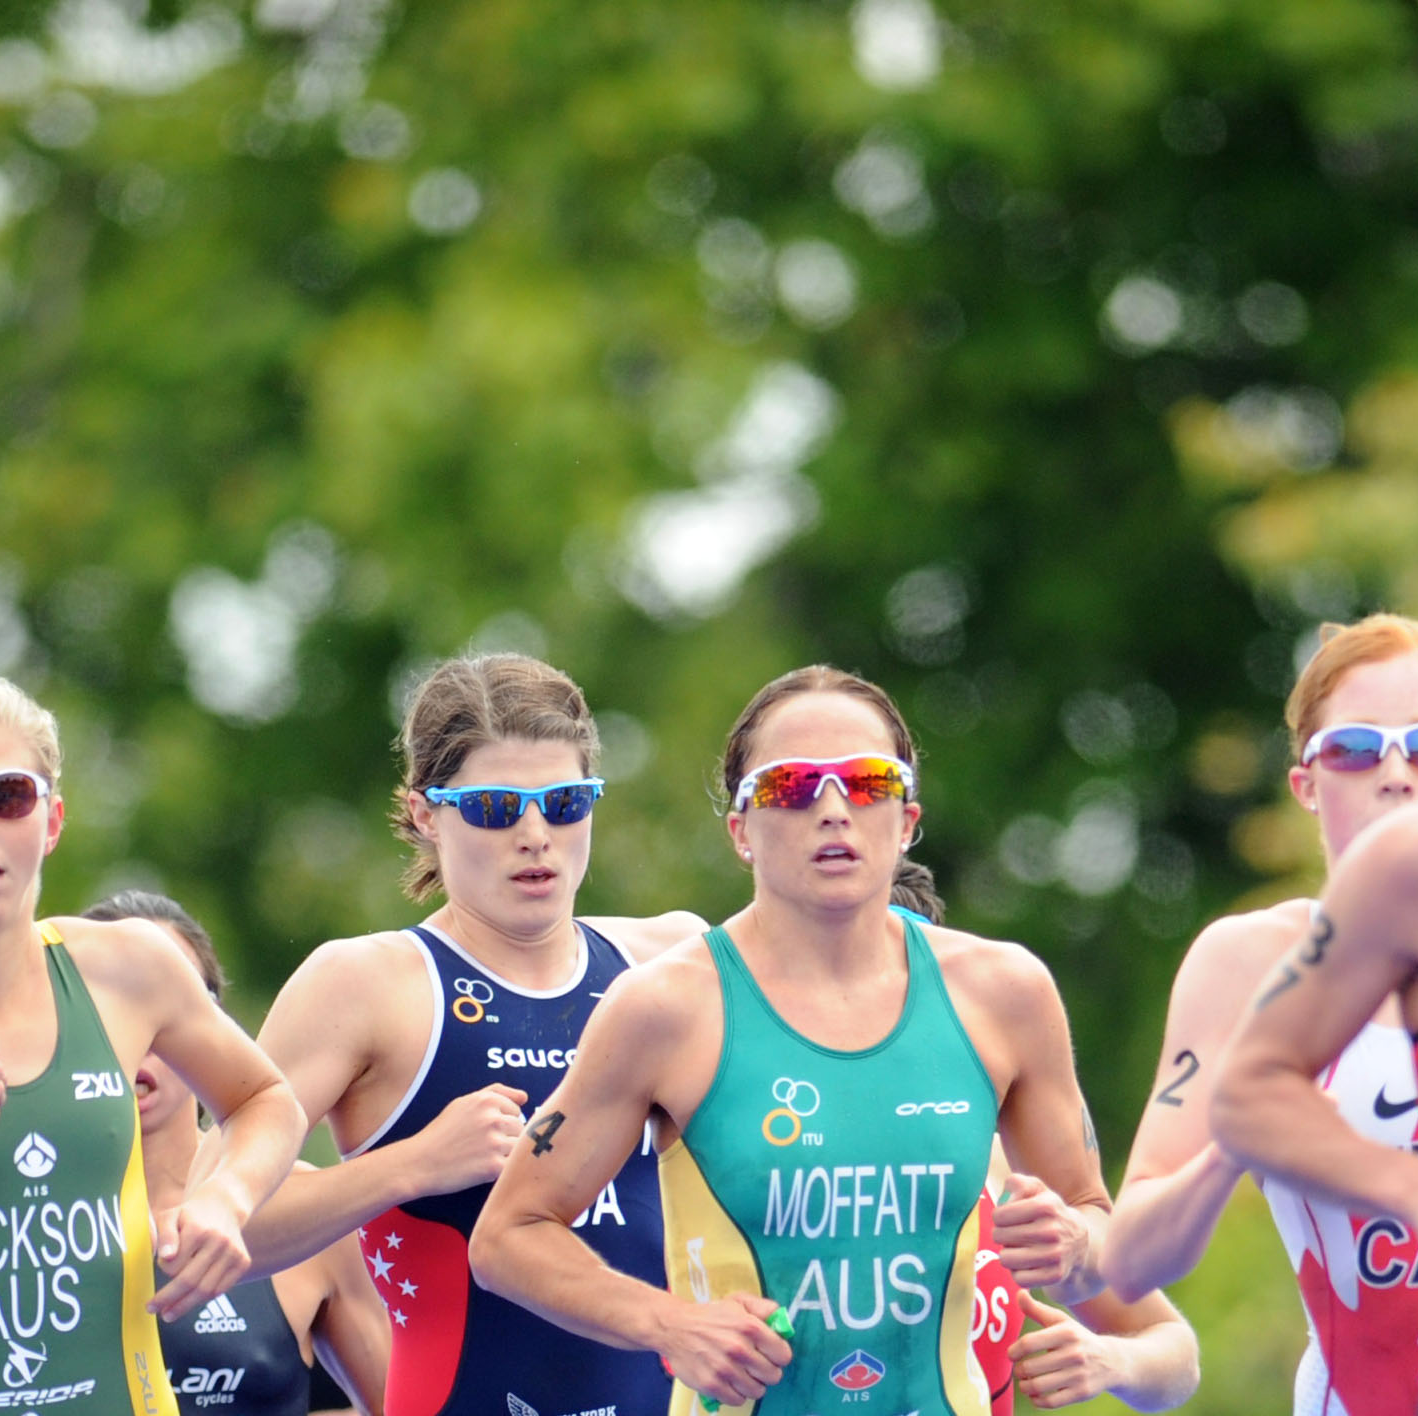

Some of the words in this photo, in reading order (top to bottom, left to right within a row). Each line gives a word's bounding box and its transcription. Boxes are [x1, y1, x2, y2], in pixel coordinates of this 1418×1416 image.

[1156, 1049, 1199, 1107] 2
[896, 1101, 970, 1116] orca
[528, 1110, 567, 1158] 4
[802, 1133, 823, 1146] ITU
[23, 1184, 49, 1197] AIS
[763, 1163, 954, 1239] MOFFATT
[788, 1254, 932, 1331] AUS
[194, 1317, 246, 1334] adidas
[195, 1392, 234, 1408] cycles
[842, 1391, 870, 1403] AIS
